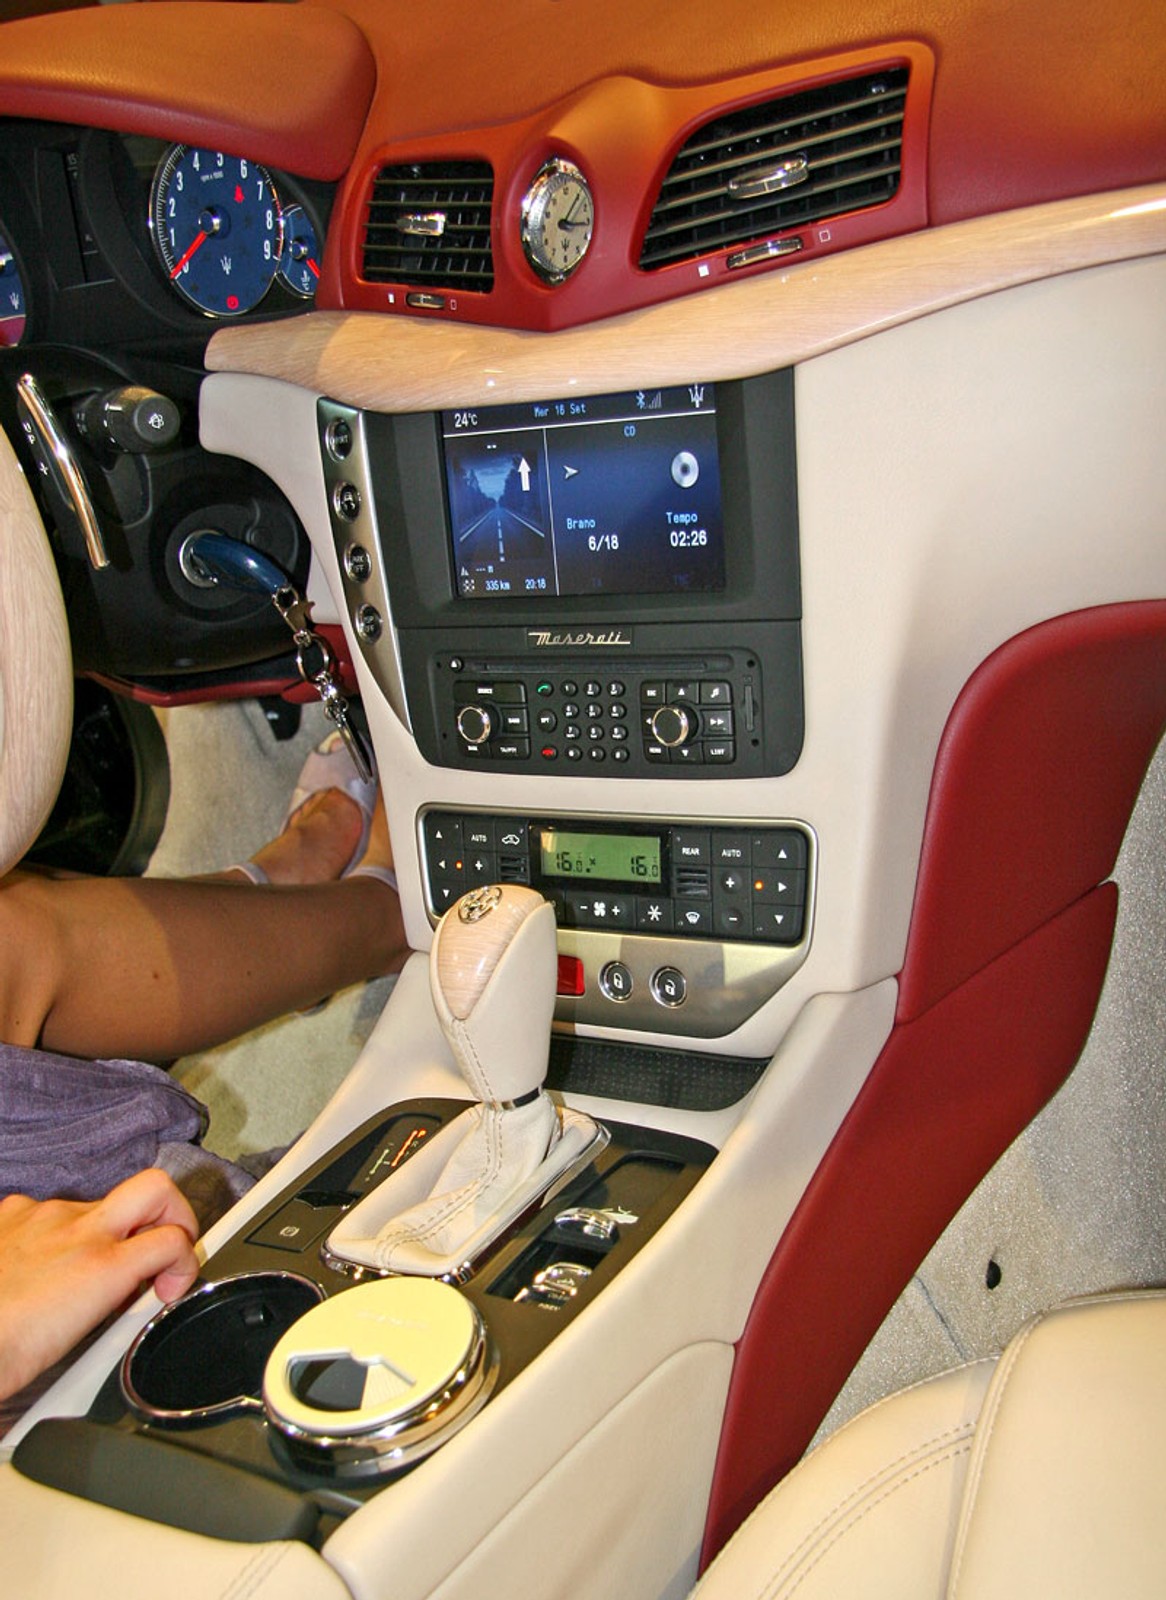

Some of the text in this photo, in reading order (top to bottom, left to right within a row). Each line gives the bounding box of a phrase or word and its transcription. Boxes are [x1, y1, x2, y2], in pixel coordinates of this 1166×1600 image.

[193, 151, 200, 171] 4
[240, 158, 248, 179] 6
[176, 171, 184, 191] 3
[256, 181, 264, 200] 7
[169, 198, 176, 217] 2
[266, 210, 273, 230] 8
[170, 228, 175, 247] 1
[263, 240, 271, 260] 9
[624, 425, 636, 437] CD
[566, 517, 596, 530] Brano
[666, 511, 698, 526] Tempo
[588, 534, 620, 551] 6/18
[670, 529, 707, 547] 02:26
[528, 631, 631, 646] Maserati
[471, 834, 488, 843] AUTO
[681, 847, 701, 856] REAR
[721, 848, 742, 858] AUTO
